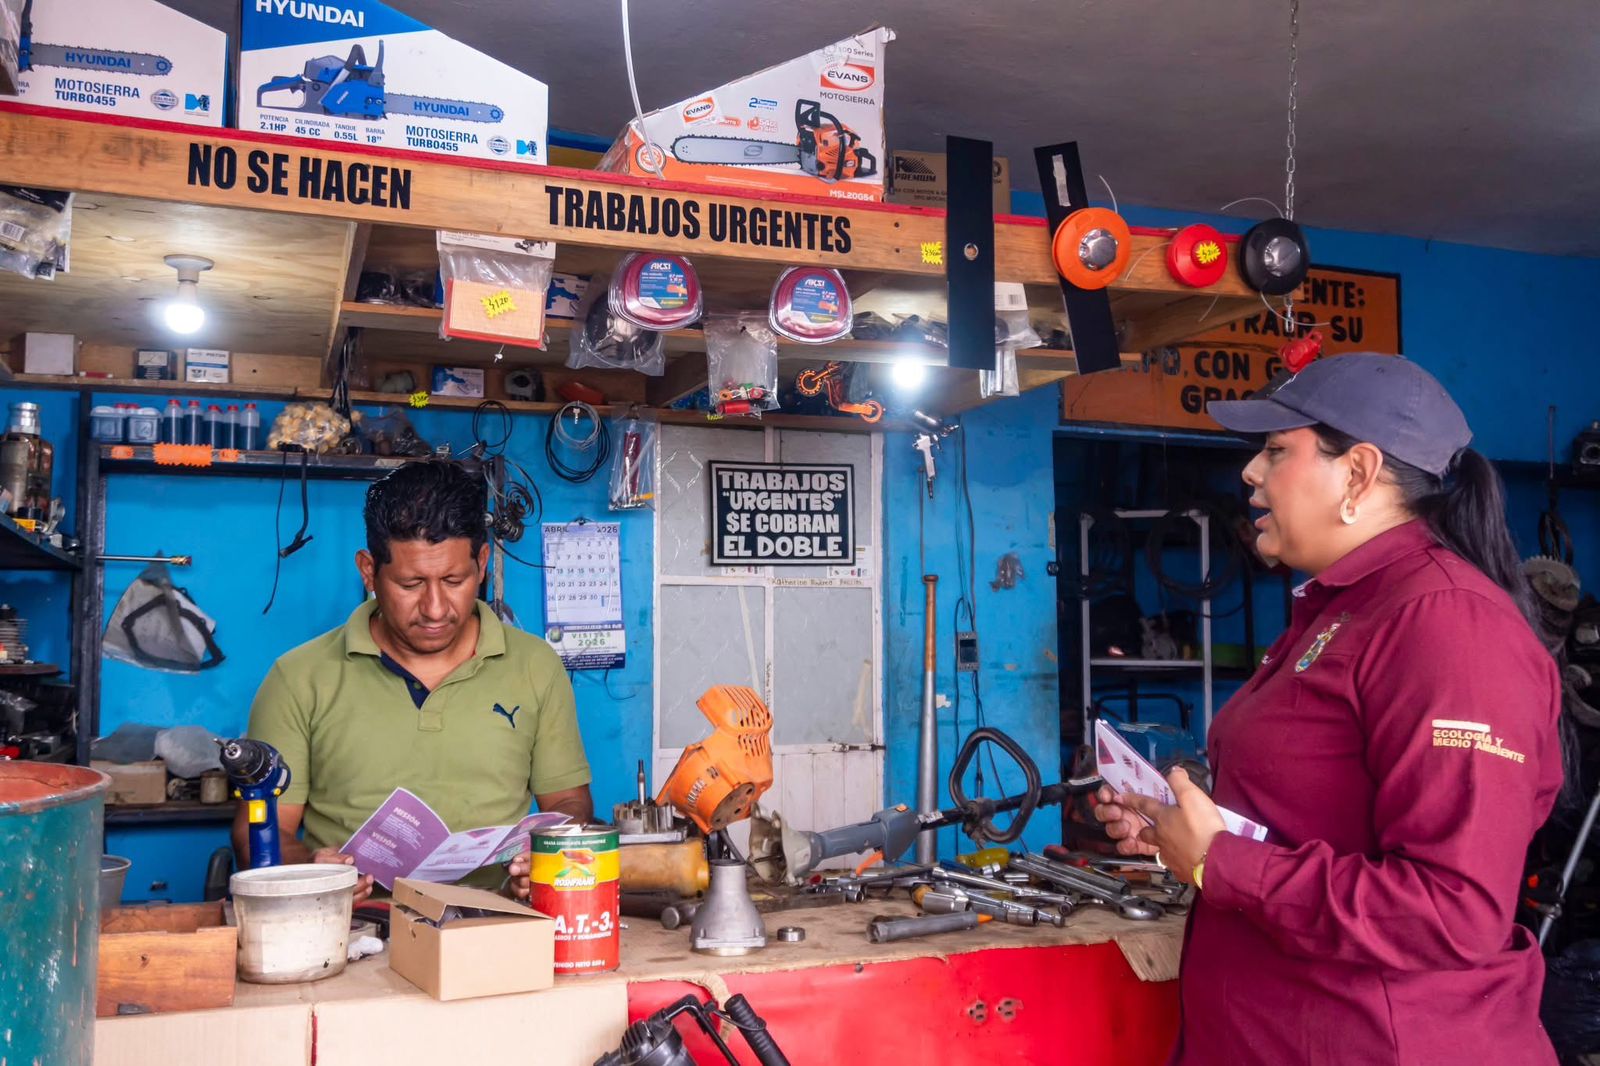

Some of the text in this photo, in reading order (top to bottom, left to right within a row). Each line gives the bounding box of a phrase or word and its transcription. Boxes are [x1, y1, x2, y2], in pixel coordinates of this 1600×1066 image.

[256, 0, 364, 27] HYUNDAI
[65, 52, 131, 68] HYUNDAI
[827, 70, 869, 83] EVANS
[54, 77, 140, 99] MOTOSIERRA
[819, 91, 875, 105] MOTOSIERRA
[413, 101, 470, 116] HYUNDAI
[685, 103, 712, 116] EVANS
[260, 114, 385, 135] POTENCIA CILINDRADA TANQUE BARRA
[260, 122, 287, 132] 2.1HP
[295, 126, 306, 135] 45
[308, 128, 320, 136] CC
[334, 131, 358, 141] 0.55L
[405, 125, 479, 144] MOTOSIERRA
[187, 142, 412, 210] NO SE HACEN
[895, 172, 936, 182] PREMIUM
[545, 185, 852, 254] TRABAJOS URGENTES
[650, 262, 672, 270] AKSI
[804, 278, 825, 287] AKSI
[1330, 315, 1364, 343] SU
[1194, 350, 1250, 381] CON
[718, 470, 846, 492] TRABAJOS
[544, 525, 618, 534] ABRIL 2026
[755, 513, 840, 534] COBRAN
[723, 535, 843, 557] EL DOBLE
[1432, 737, 1526, 764] MEDIO AMBIENTE
[1495, 737, 1504, 748] Y
